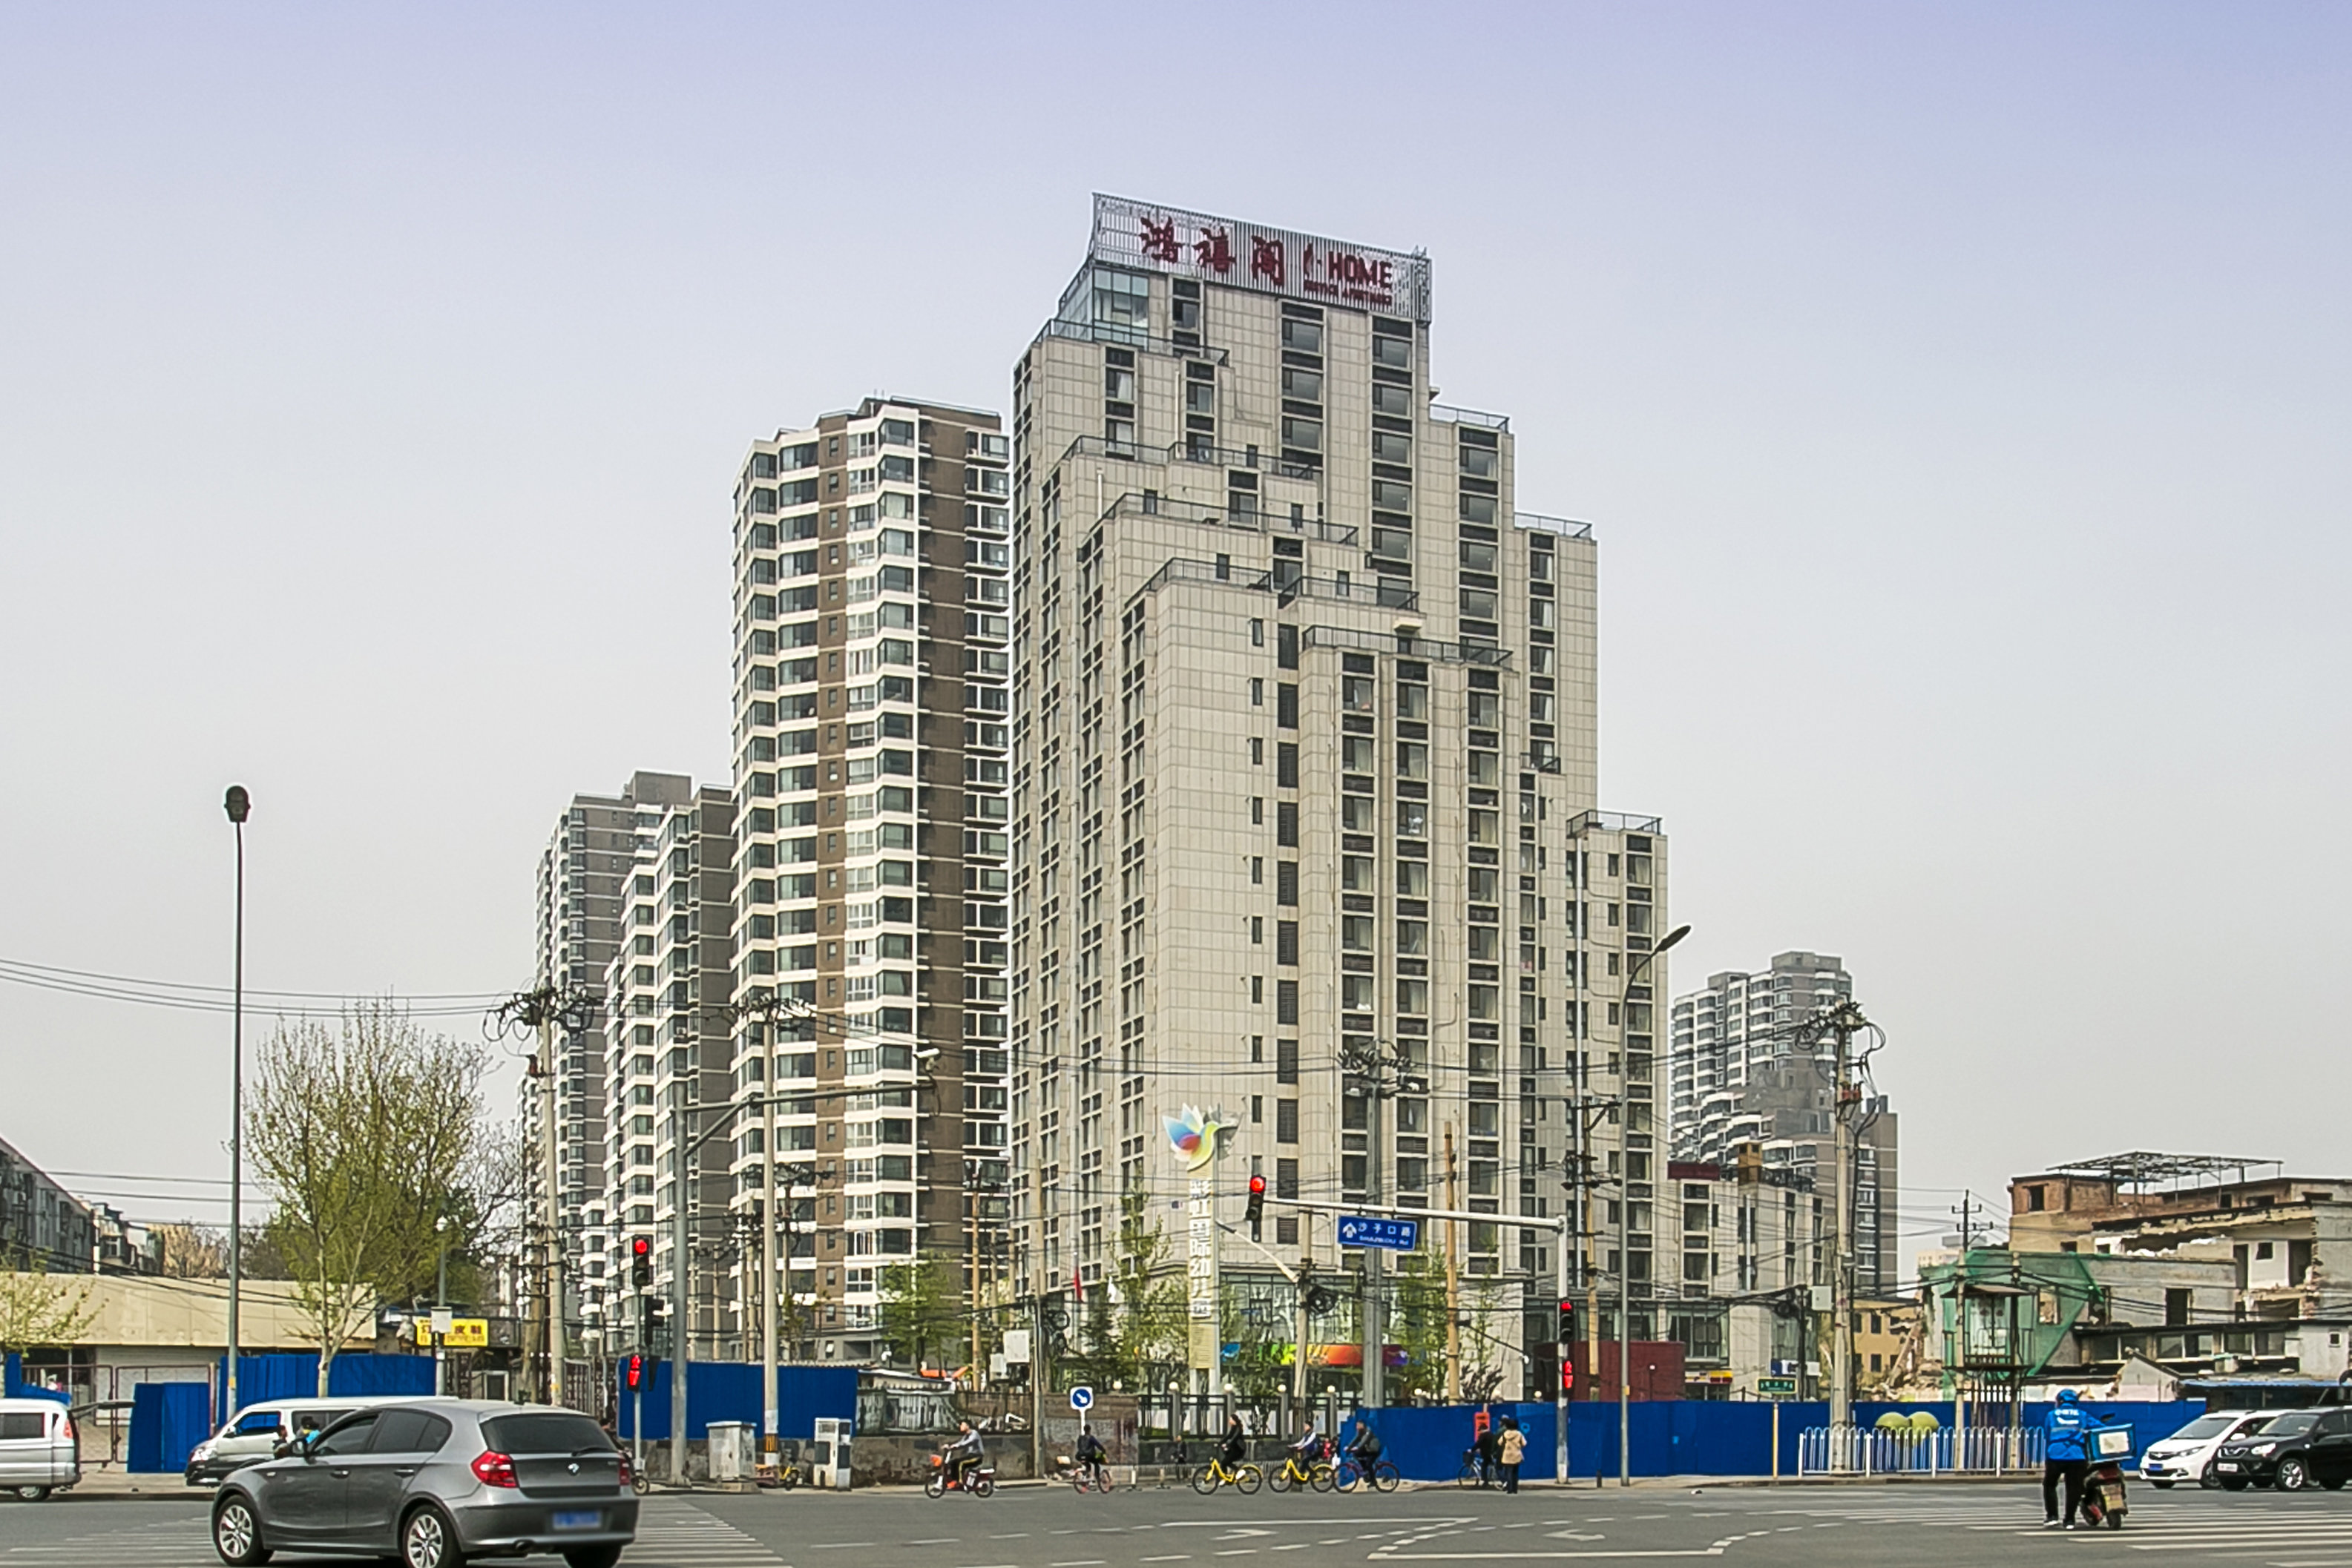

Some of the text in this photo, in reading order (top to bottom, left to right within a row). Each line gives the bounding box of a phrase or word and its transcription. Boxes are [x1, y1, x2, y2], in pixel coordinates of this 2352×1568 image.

[1189, 1178, 1212, 1317] 彩虹国际幼儿园
[1358, 1222, 1410, 1237] 沙子口路
